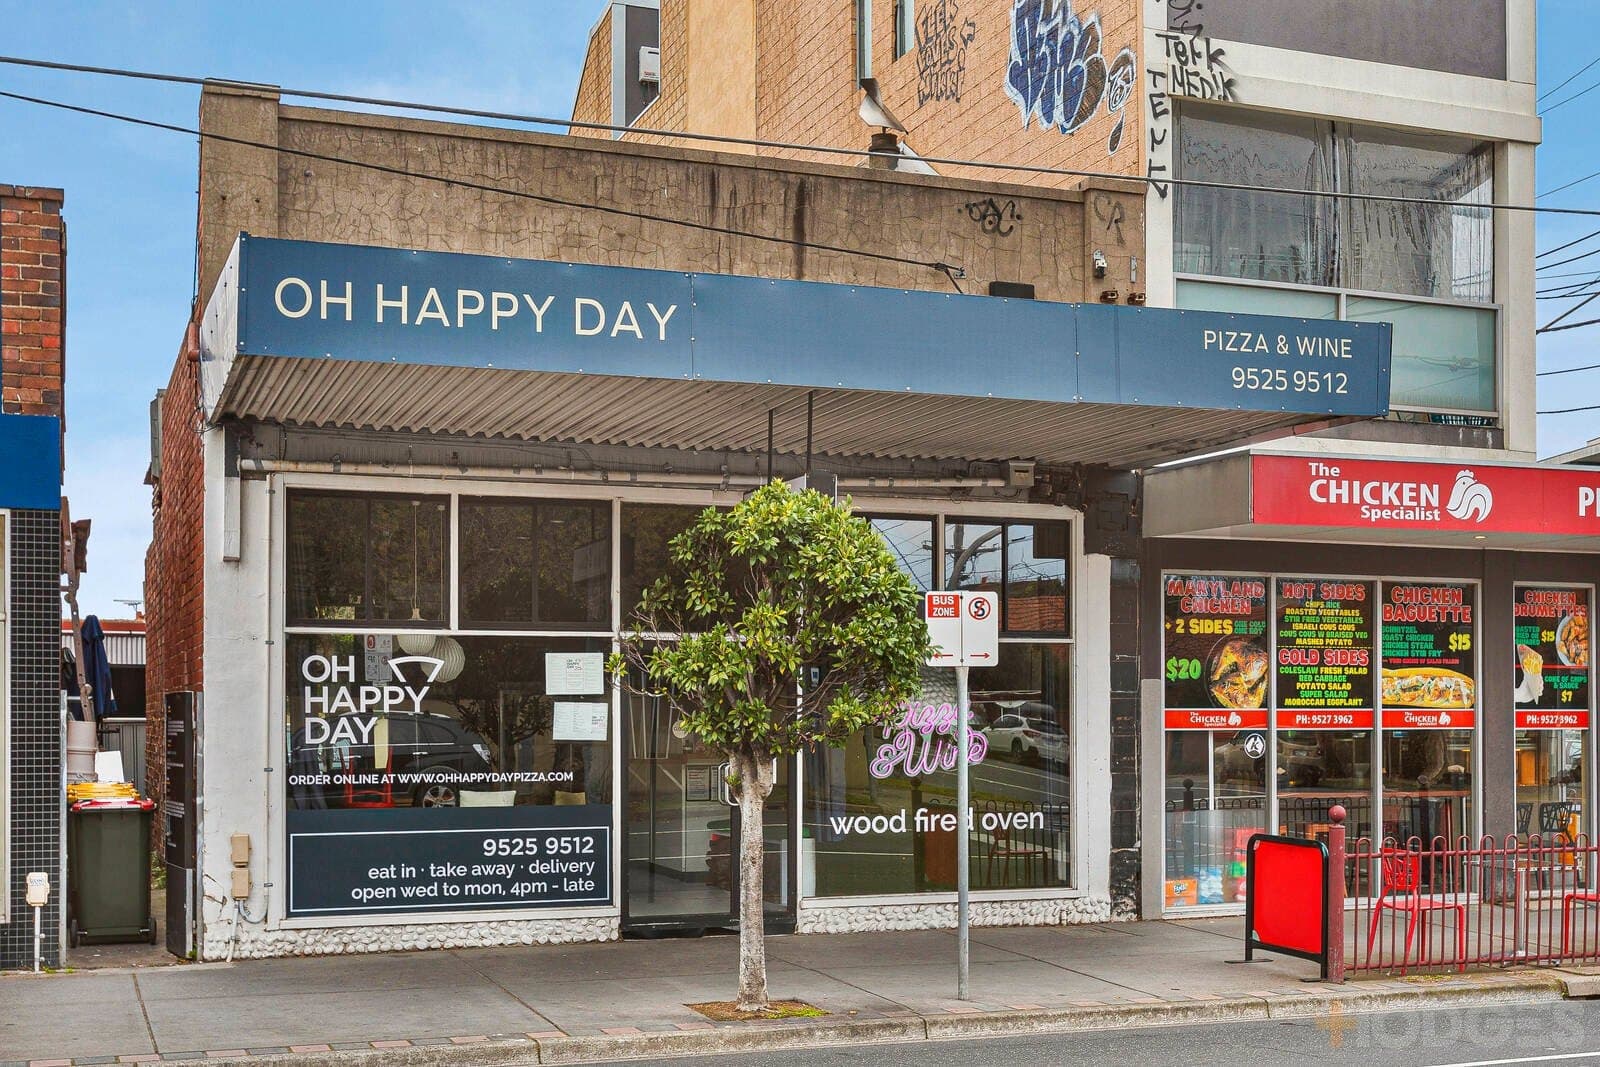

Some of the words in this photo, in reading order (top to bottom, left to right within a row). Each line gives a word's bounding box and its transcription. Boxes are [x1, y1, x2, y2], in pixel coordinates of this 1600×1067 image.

[274, 277, 353, 322] OH
[376, 283, 556, 333] HAPPY
[575, 297, 678, 341] DAY
[1203, 330, 1270, 353] PIZZA
[1276, 334, 1289, 355] &
[1296, 336, 1353, 358] WINE
[1231, 366, 1288, 391] 9525
[1293, 370, 1348, 394] 9512
[1308, 462, 1341, 477] The
[1308, 478, 1440, 508] CHICKEN
[1360, 505, 1440, 522] Specialist
[1166, 580, 1265, 598] MARYLAND
[1282, 582, 1316, 599] HOT
[1321, 583, 1366, 601] SIDES
[1391, 586, 1463, 605] CHICKEN
[932, 596, 955, 605] BUS
[1524, 590, 1577, 604] CHICKEN
[932, 607, 955, 617] ZONE
[1180, 597, 1252, 614] CHICKEN
[1285, 608, 1318, 616] ROASTED
[1318, 608, 1360, 616] VEGETABLES
[1325, 601, 1341, 609] RICE
[1321, 616, 1364, 624] VEGETABLES
[1383, 604, 1472, 623] BAGUETTE
[1175, 618, 1185, 634] 2
[1189, 618, 1233, 635] SIDES
[1292, 623, 1318, 631] ISRAELI
[1319, 623, 1337, 631] COUS
[1298, 630, 1316, 638] COUS
[1325, 638, 1353, 646] POTATO
[1448, 632, 1471, 652] $15
[1541, 629, 1556, 643] $15
[1278, 649, 1320, 665] COLD
[1323, 649, 1369, 666] SIDES
[301, 654, 355, 683] OH
[1166, 656, 1202, 682] $20
[1279, 666, 1319, 674] COLESLAW
[1319, 666, 1343, 674] FRESH
[1343, 666, 1368, 675] SALAD
[1298, 674, 1313, 682] RED
[1296, 682, 1326, 690] POTATO
[1327, 682, 1352, 691] SALAD
[1323, 690, 1349, 698] SALAD
[304, 685, 430, 713] HAPPY
[1284, 698, 1326, 706] MOROCCAN
[1326, 698, 1363, 706] EGGPLANT
[1561, 689, 1573, 703] $7
[1190, 715, 1227, 723] CHICKEN
[1295, 714, 1310, 724] PH:
[1311, 714, 1333, 725] 9527
[1333, 714, 1353, 725] 3962
[1404, 715, 1438, 723] CHICKEN
[1526, 715, 1540, 724] PH:
[1540, 715, 1558, 724] 9527
[1559, 715, 1578, 724] 3962
[304, 716, 378, 745] DAY
[288, 774, 331, 785] ORDER
[333, 774, 379, 785] ONLINE
[380, 774, 397, 785] AT
[397, 772, 574, 784] WWW.OHHAPPYDAYPIZZA.COM
[829, 808, 907, 835] wood
[981, 811, 1045, 830] oven
[483, 838, 538, 857] 9525
[545, 836, 594, 854] 9512
[368, 864, 397, 880] eat
[401, 863, 416, 878] in
[429, 861, 468, 878] take
[470, 864, 516, 881] away
[528, 858, 596, 877] delivery
[351, 886, 396, 903] open
[400, 882, 438, 898] wed
[442, 882, 460, 897] to
[464, 882, 506, 898] mon,
[510, 880, 548, 898] 4pm
[563, 877, 595, 893] late
